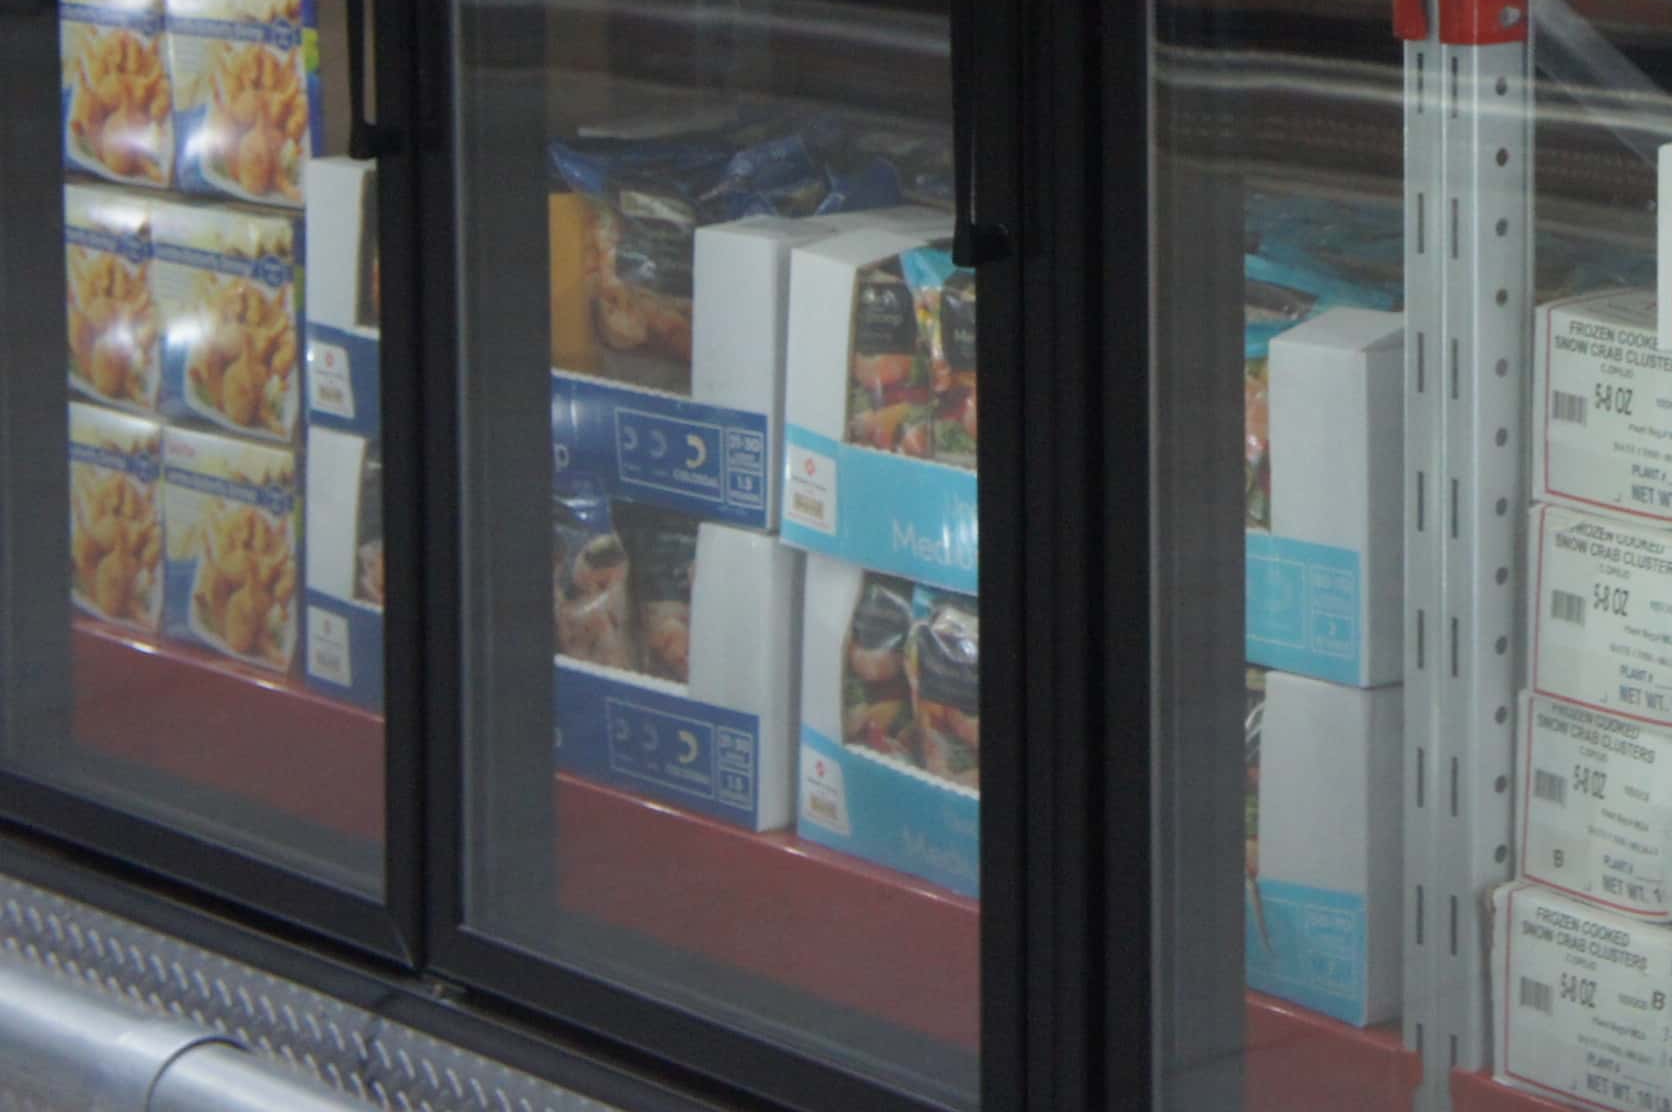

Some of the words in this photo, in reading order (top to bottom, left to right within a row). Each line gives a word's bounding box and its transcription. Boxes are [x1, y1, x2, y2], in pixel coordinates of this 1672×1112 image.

[1555, 335, 1588, 355] SNOW
[1591, 342, 1624, 362] CRAB
[1569, 320, 1615, 341] FROZEN
[1617, 330, 1659, 350] COOKE
[1615, 387, 1634, 416] OZ
[1631, 484, 1656, 505] NET
[1555, 532, 1588, 554] SNOW
[1591, 542, 1621, 562] CRAB
[1619, 684, 1642, 705] NET
[1536, 906, 1580, 931] FROZEN
[1582, 919, 1631, 947] COOKED
[1588, 940, 1649, 971] CLUSTERS
